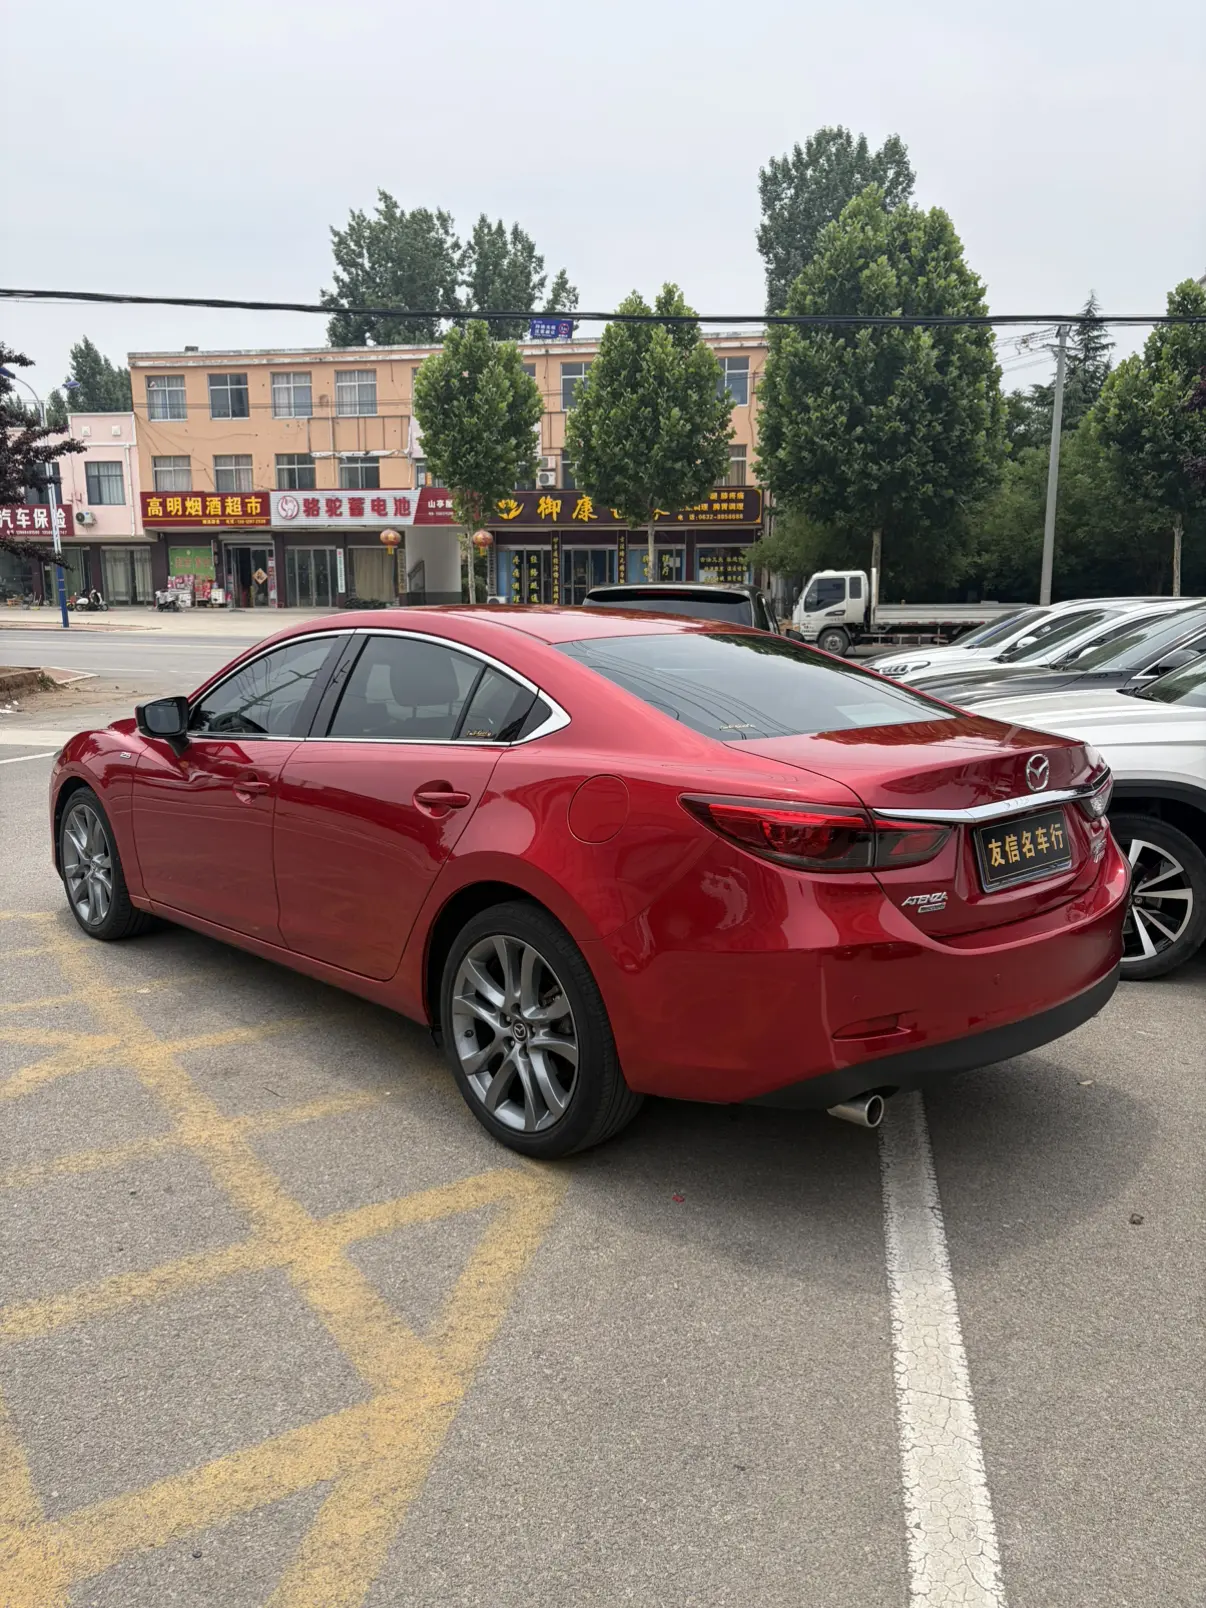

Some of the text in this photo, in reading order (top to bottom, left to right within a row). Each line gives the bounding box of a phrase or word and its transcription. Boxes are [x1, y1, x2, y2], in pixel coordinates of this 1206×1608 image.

[146, 496, 262, 516] 高明烟酒超市
[302, 496, 411, 517] 骆驼蓄电池
[988, 823, 1064, 868] 友信名车行
[901, 891, 949, 907] ATENZA
